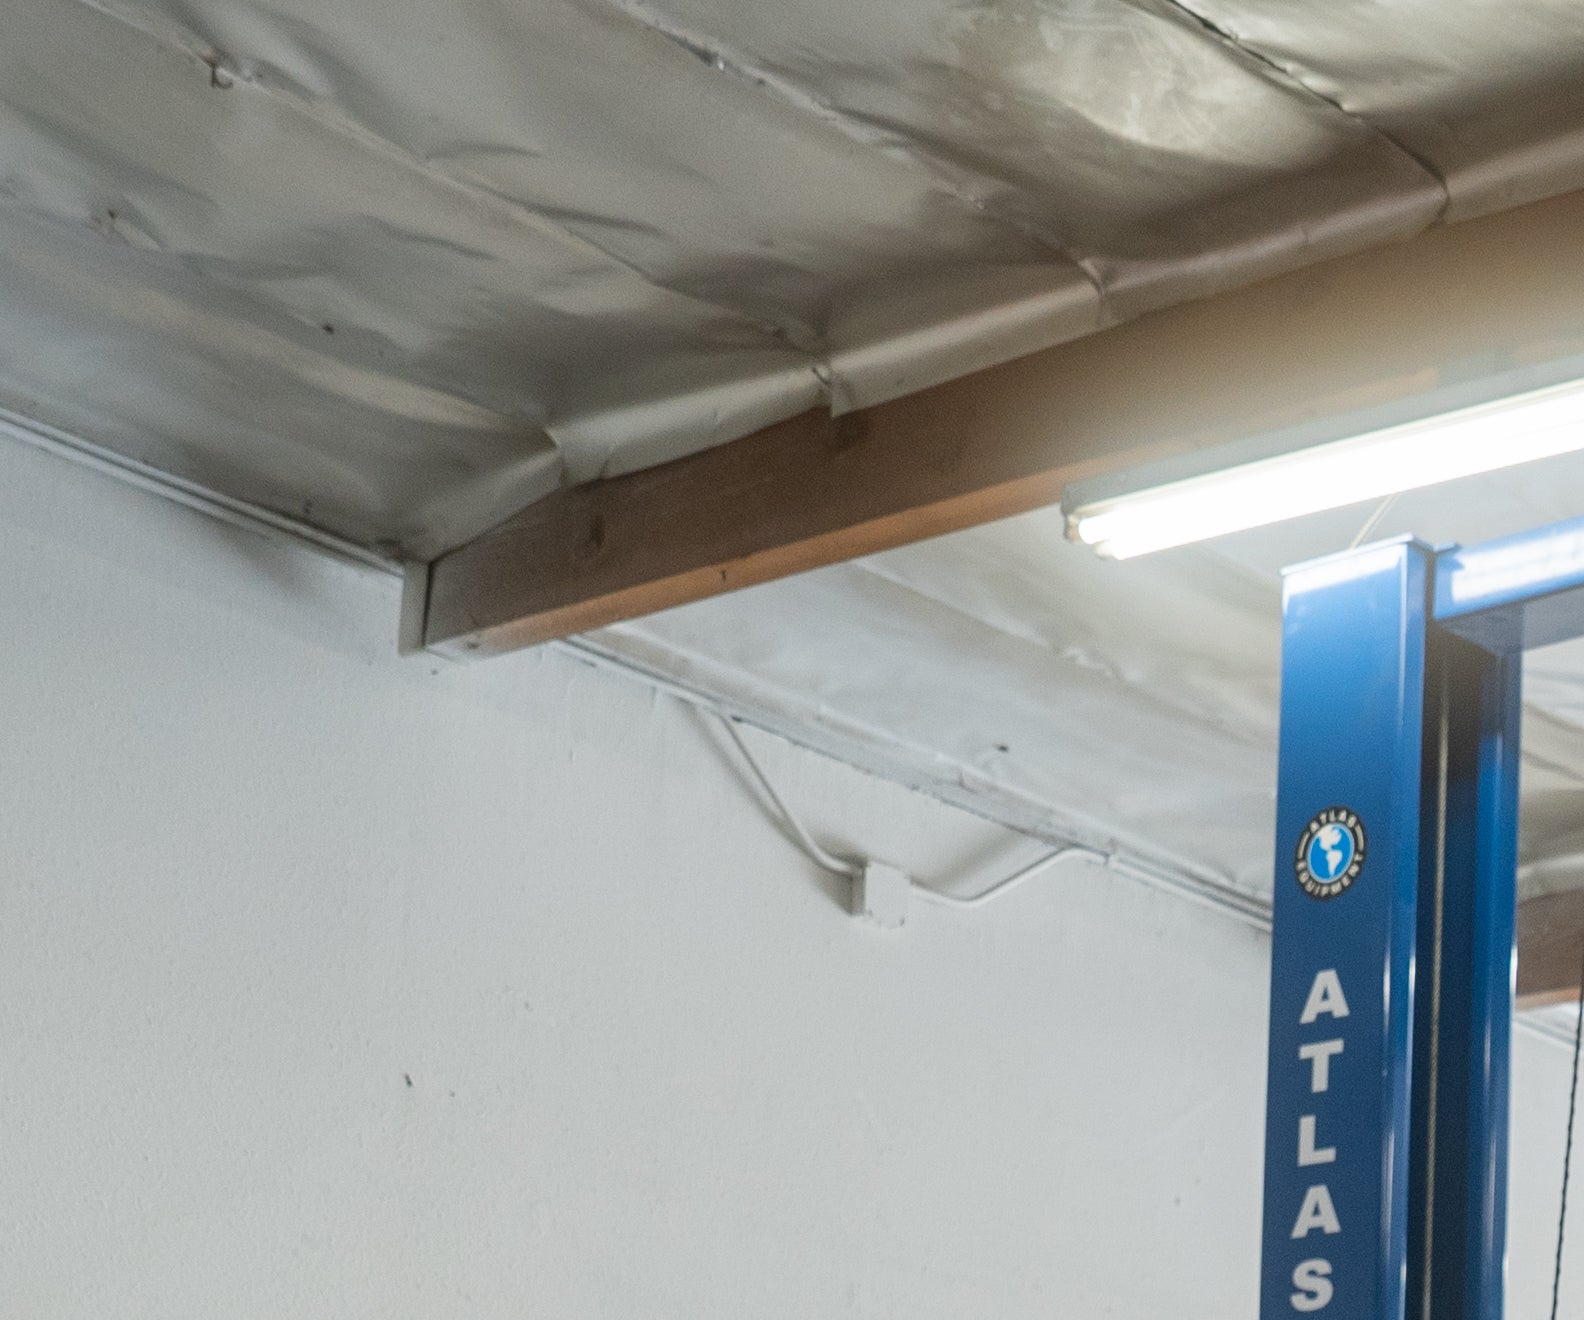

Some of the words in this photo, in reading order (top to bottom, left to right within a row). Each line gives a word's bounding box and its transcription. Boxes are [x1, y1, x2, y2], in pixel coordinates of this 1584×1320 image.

[1310, 809, 1357, 833] ATLAS
[1295, 853, 1364, 897] EQUIPMENT
[1290, 968, 1350, 1312] ATLAS
